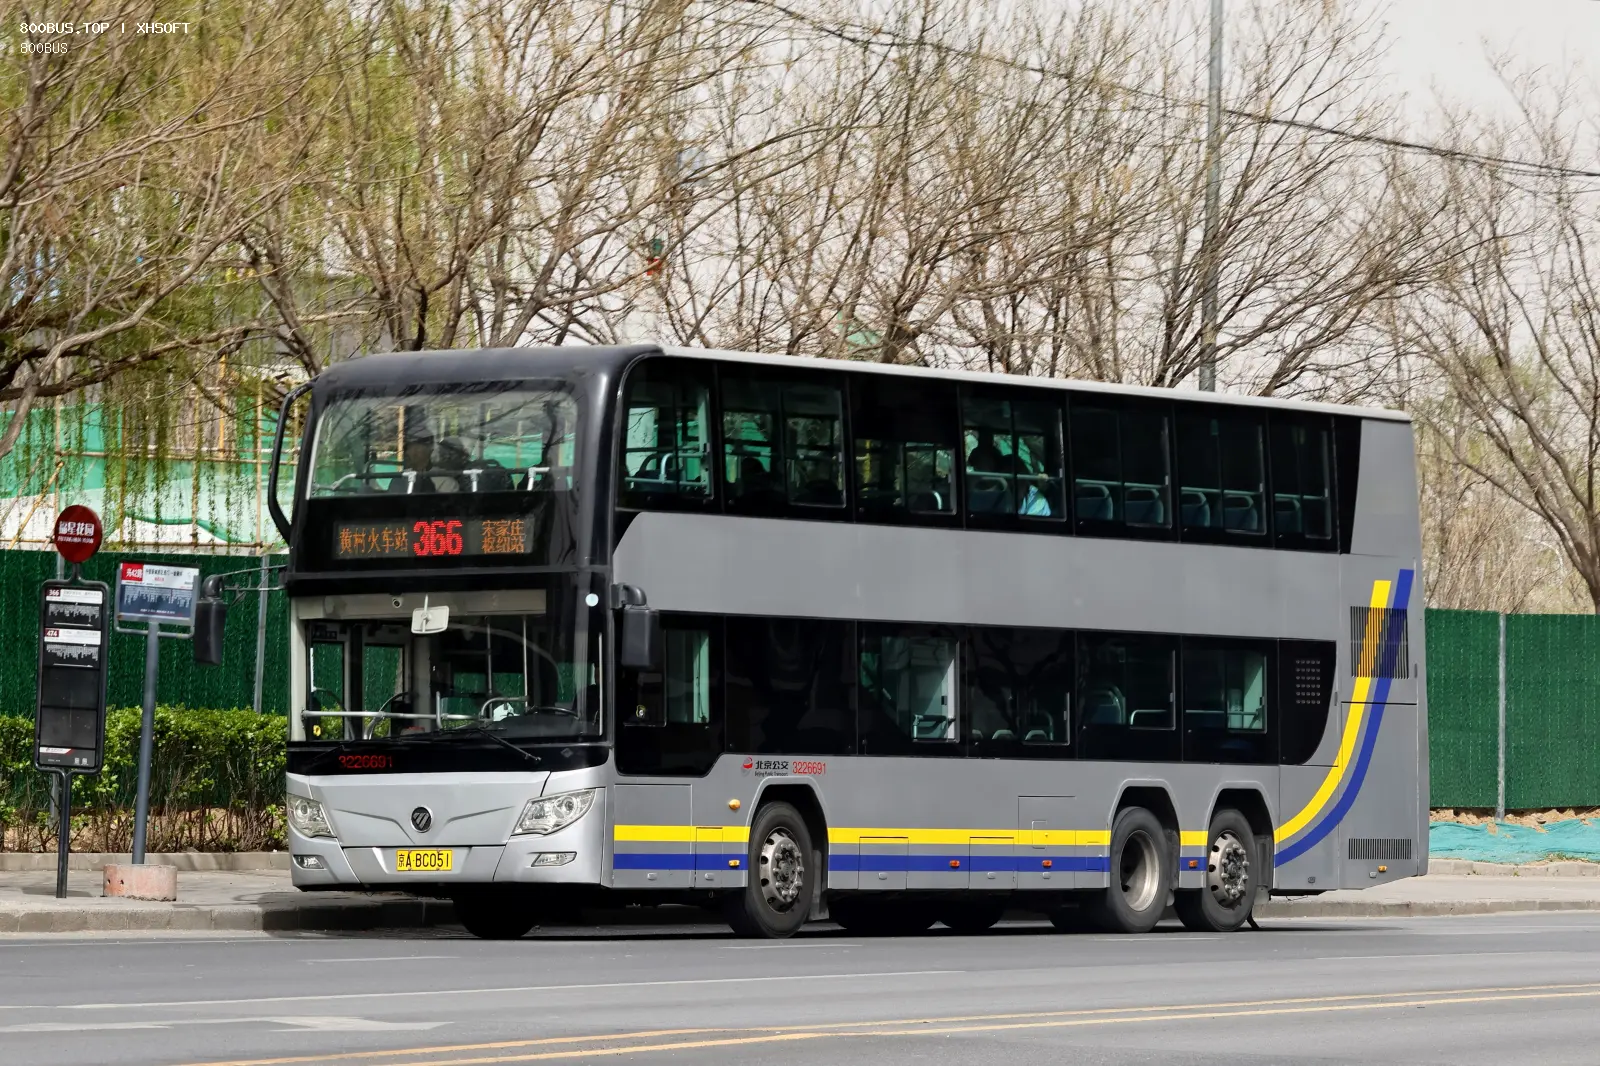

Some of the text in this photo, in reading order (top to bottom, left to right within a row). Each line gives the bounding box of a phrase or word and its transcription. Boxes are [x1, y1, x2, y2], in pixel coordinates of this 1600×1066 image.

[481, 519, 525, 537] 宋家庄
[339, 527, 408, 554] 黄村火车站
[413, 520, 463, 556] 366
[338, 755, 393, 769] 3226691
[755, 760, 788, 769] 北京公交
[792, 761, 826, 775] 3226691
